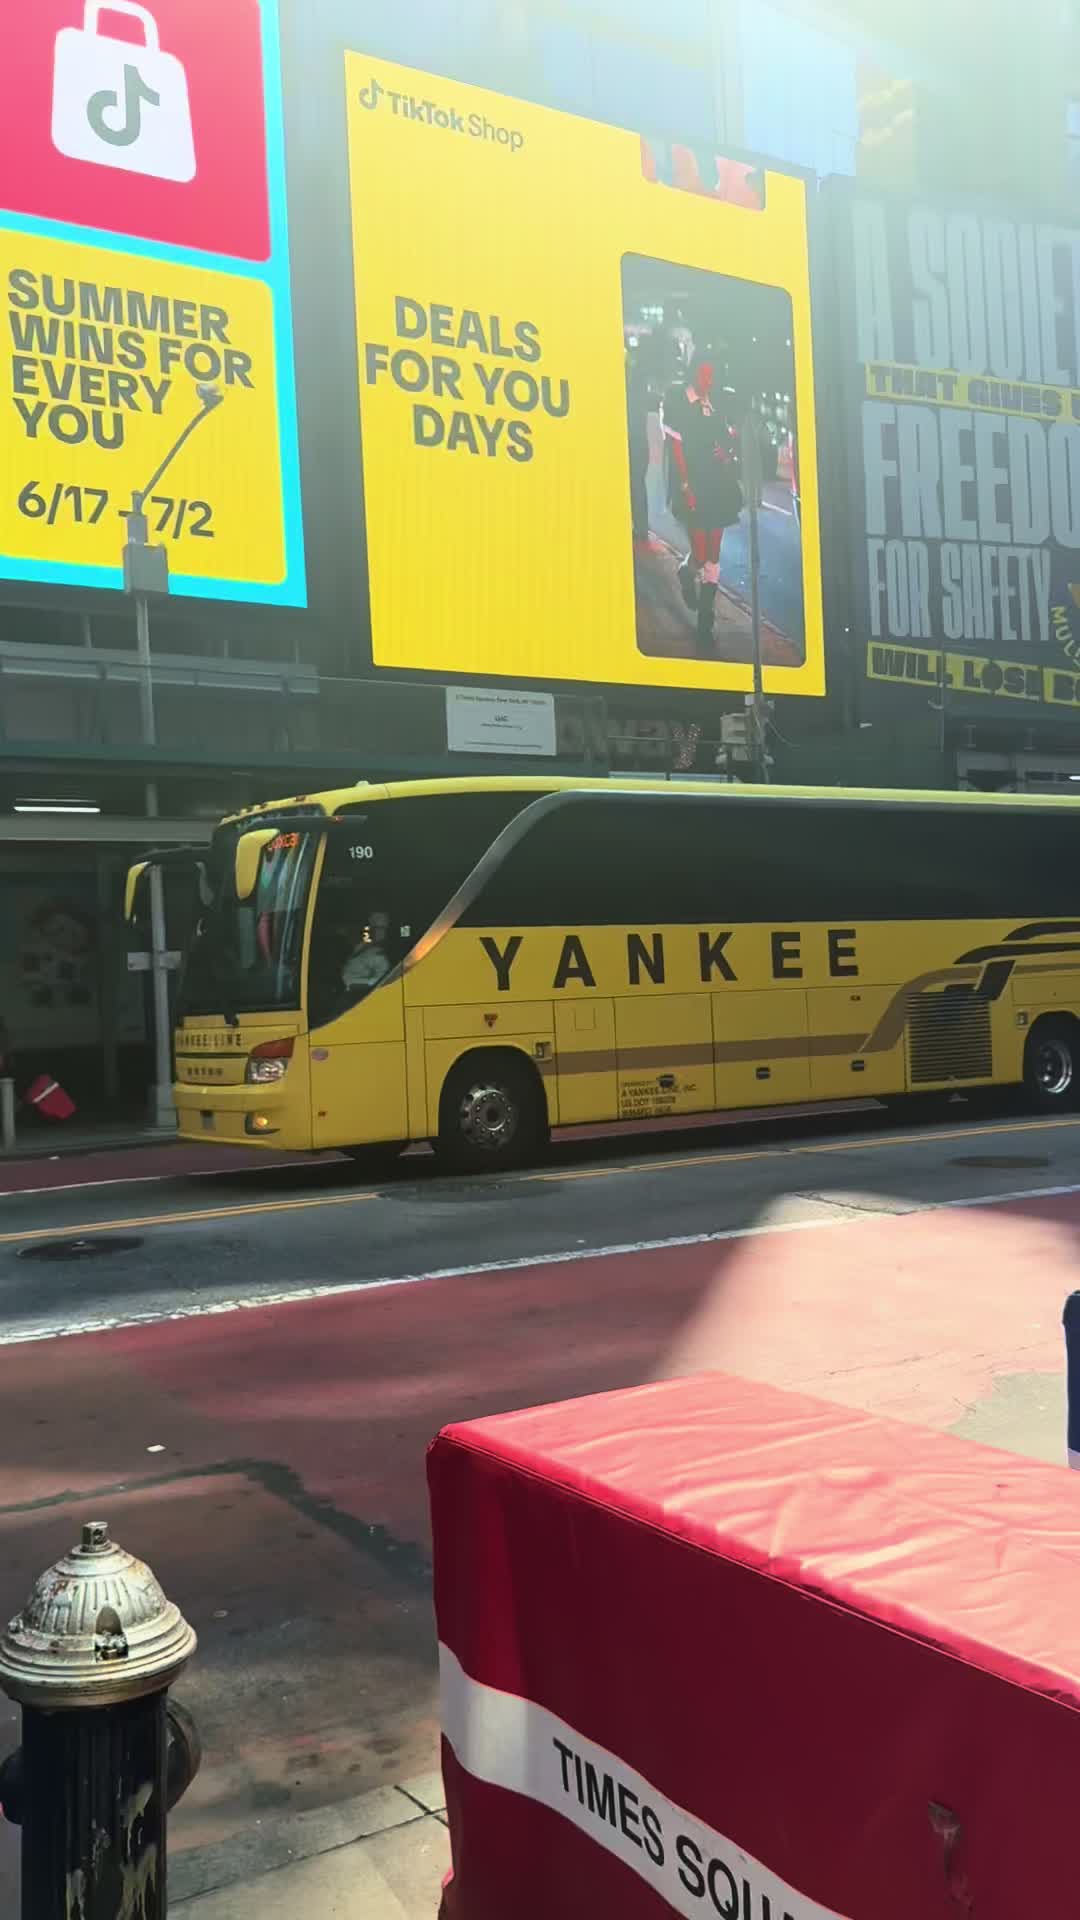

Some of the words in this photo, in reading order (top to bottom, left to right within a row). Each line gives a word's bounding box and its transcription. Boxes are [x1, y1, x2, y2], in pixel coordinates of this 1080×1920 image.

[386, 90, 465, 133] TikTok
[467, 113, 524, 152] Shop
[7, 268, 232, 345] SUMMER
[852, 202, 895, 367] A
[8, 310, 147, 371] WINS
[158, 336, 256, 389] FOR
[394, 295, 541, 363] DEALS
[12, 354, 172, 415] EVERY
[364, 342, 465, 401] FOR
[472, 362, 571, 418] YOU
[869, 366, 958, 402] THAT
[968, 377, 1062, 418] GIVES
[12, 396, 124, 450] YOU
[413, 403, 534, 463] DAYS
[17, 480, 109, 525] 6/17
[151, 495, 215, 540] 7/2
[866, 539, 932, 637] FOR
[940, 542, 1051, 641] SAFETY
[872, 648, 954, 687] WILL
[349, 846, 373, 858] 190
[479, 928, 859, 991] YANKEE
[552, 1736, 665, 1867] TIMES
[676, 1834, 795, 1920] SQU
